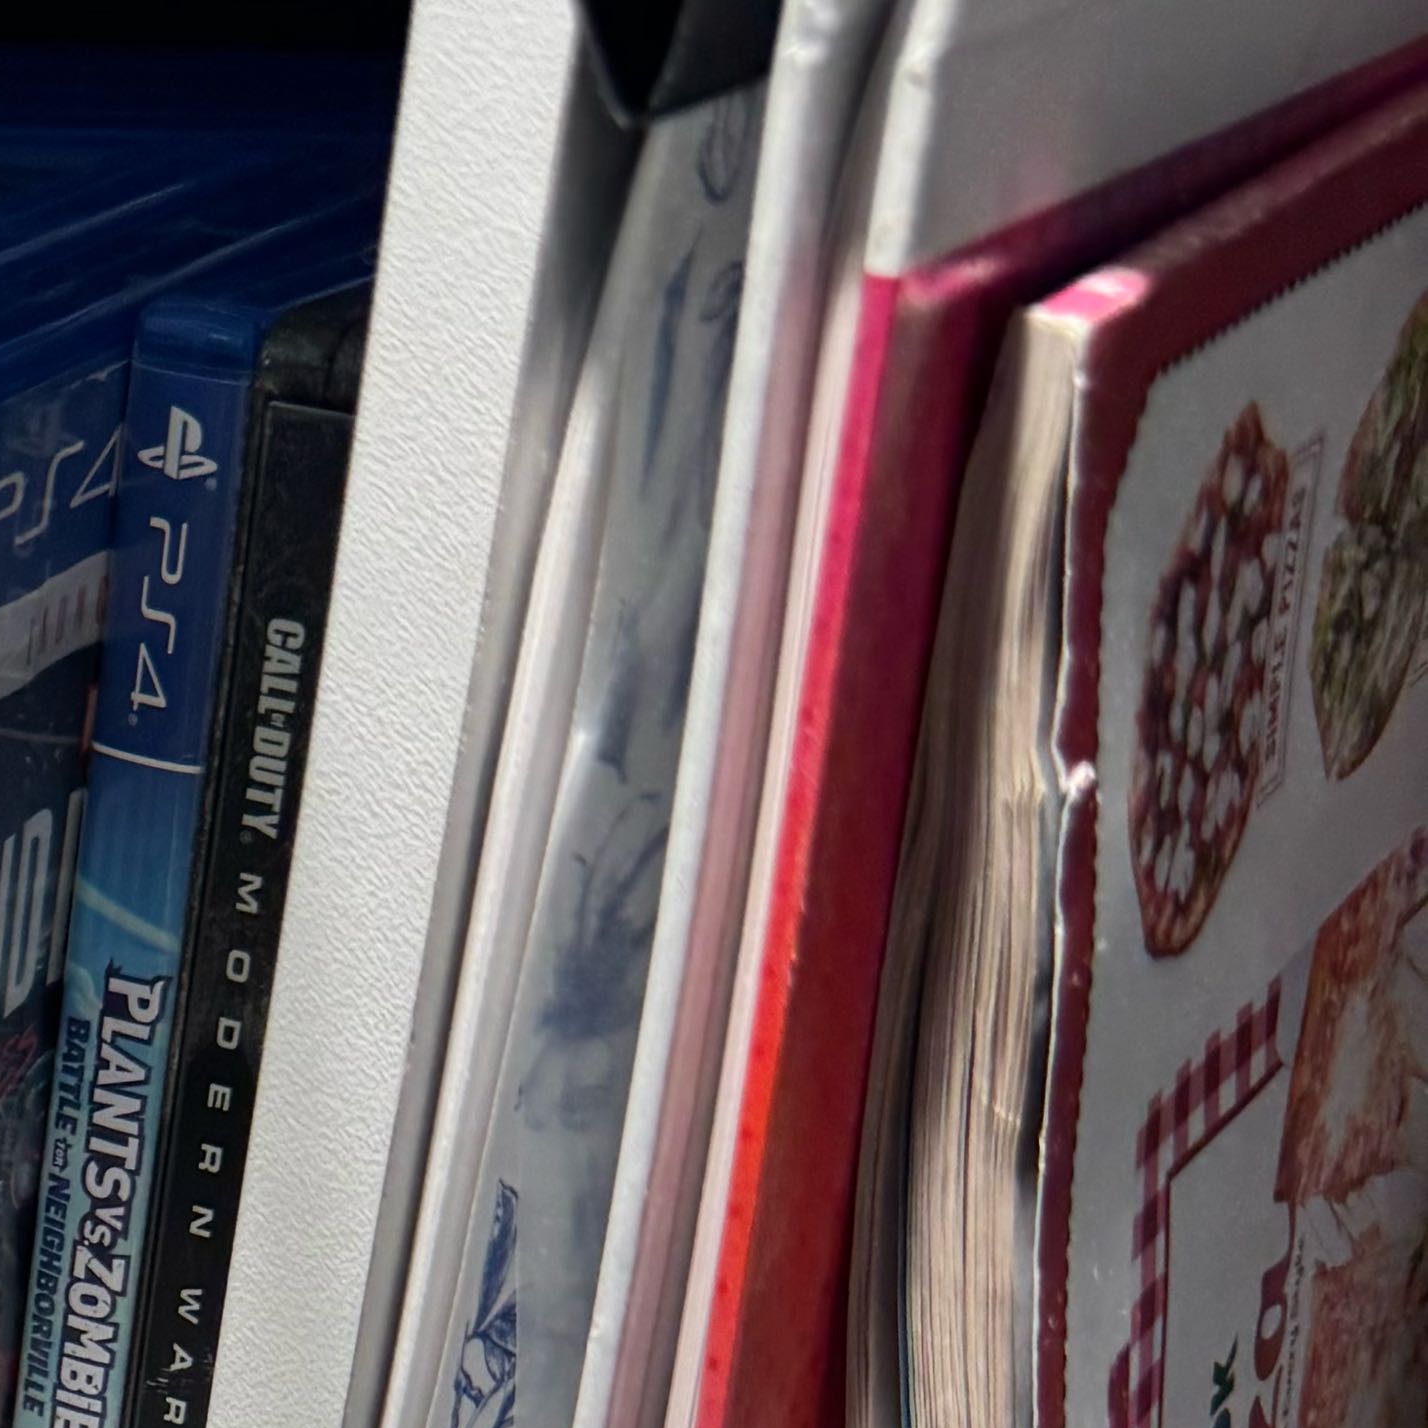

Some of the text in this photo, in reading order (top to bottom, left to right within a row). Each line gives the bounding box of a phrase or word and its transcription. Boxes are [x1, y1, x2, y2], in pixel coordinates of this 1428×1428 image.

[257, 617, 306, 716] CALL
[241, 724, 292, 841] DUTY
[53, 1014, 91, 1139] BATTLE
[83, 974, 168, 1203] PLANTS
[188, 870, 264, 1239] MODERN
[23, 1172, 71, 1419] NEIGHBORVILLE
